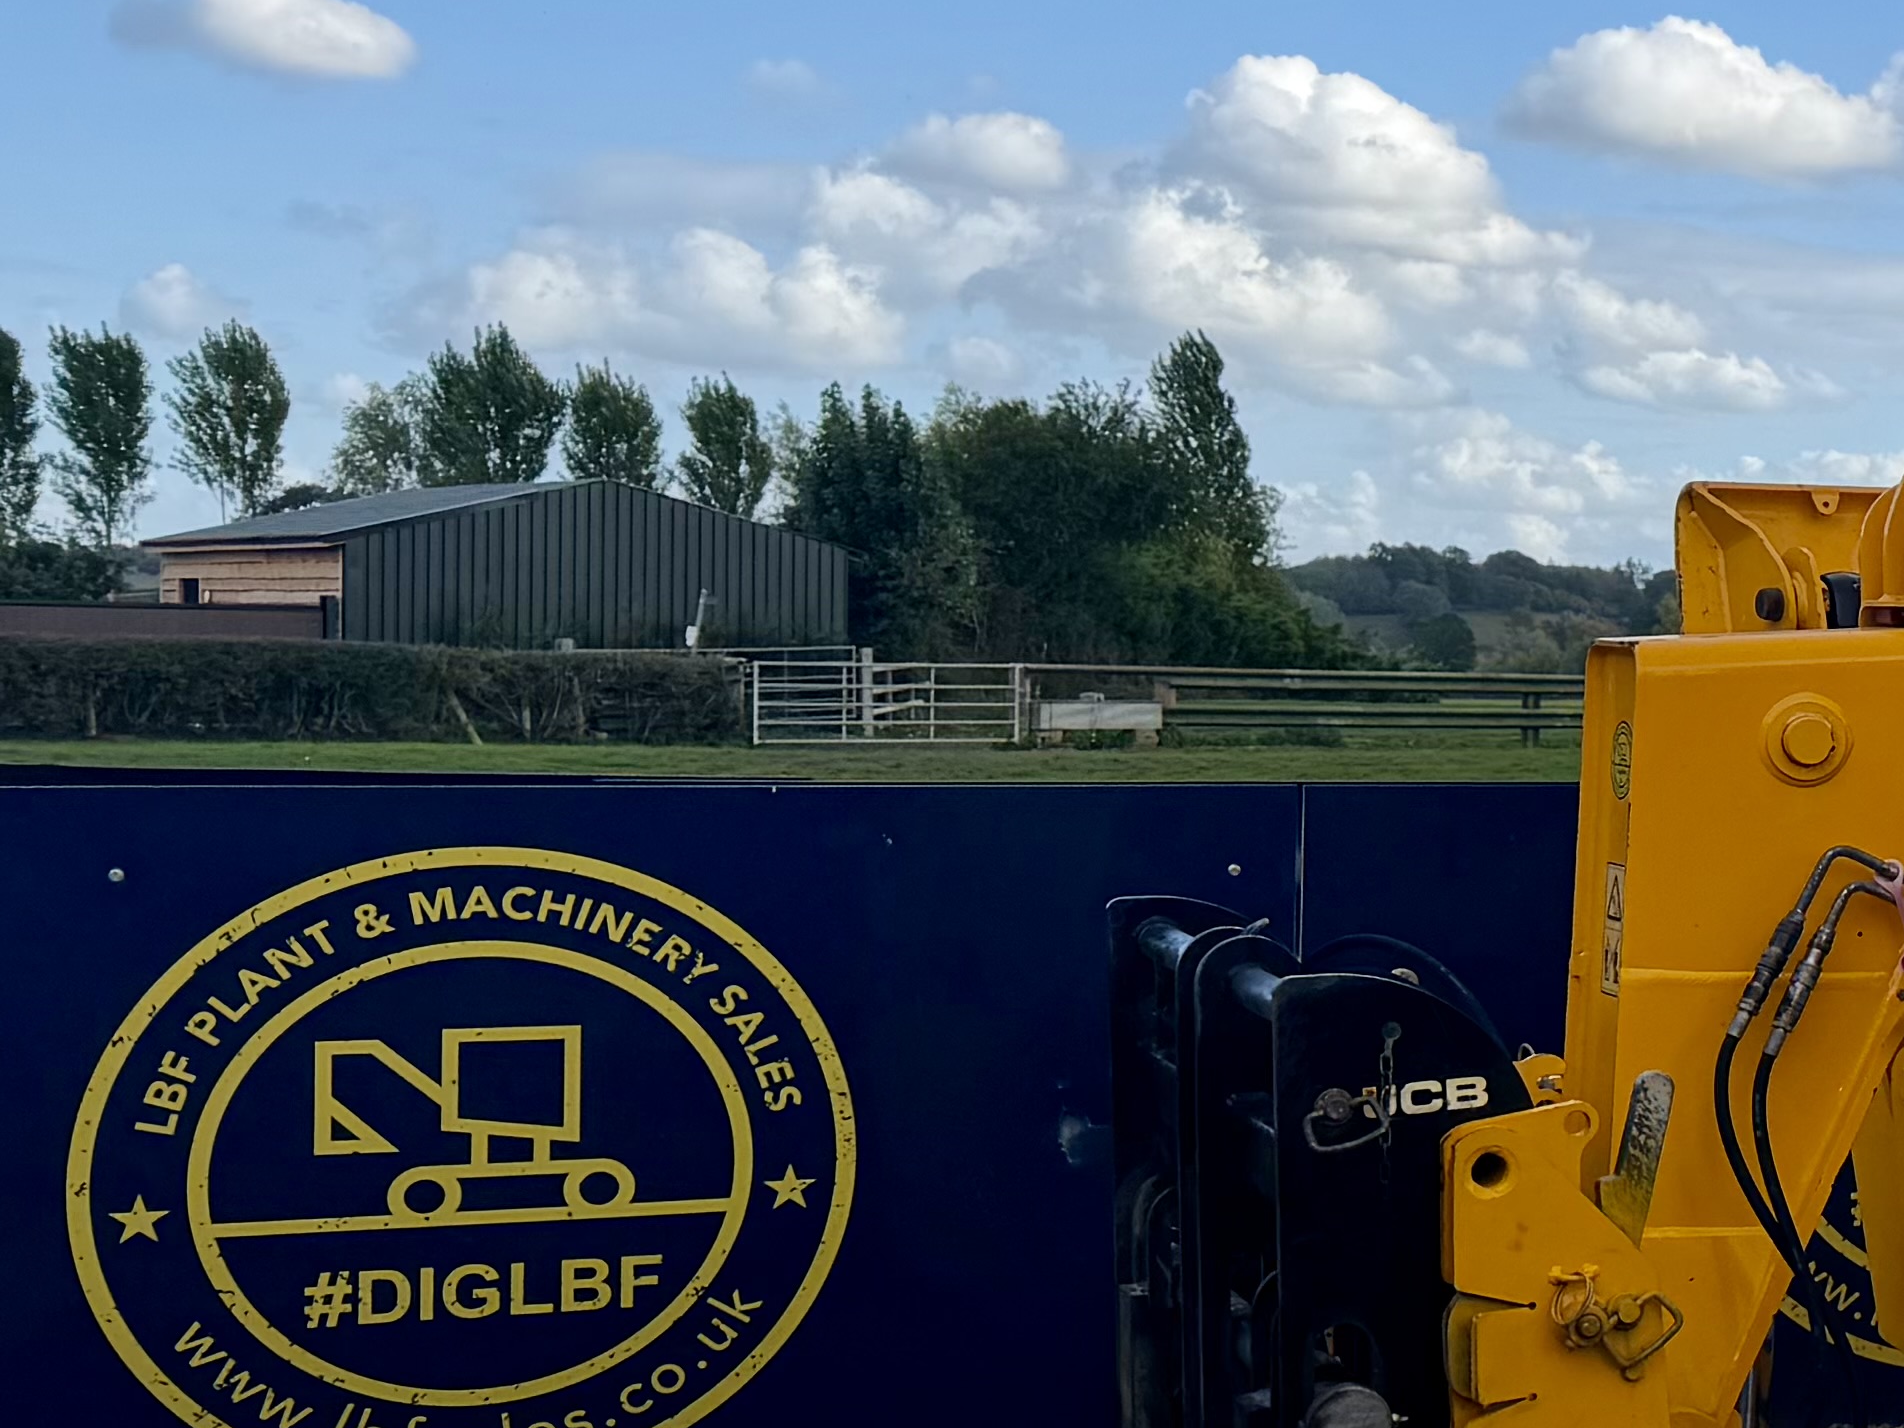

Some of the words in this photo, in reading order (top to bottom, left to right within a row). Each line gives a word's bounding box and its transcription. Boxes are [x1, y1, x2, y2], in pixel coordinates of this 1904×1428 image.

[134, 1050, 196, 1136] LBF
[185, 922, 333, 1046] PLANT
[355, 903, 392, 940] &
[410, 887, 719, 985] MACHINERY
[709, 985, 803, 1114] SALES
[1362, 1076, 1489, 1121] JCB
[304, 1254, 664, 1329] #DIGLBF
